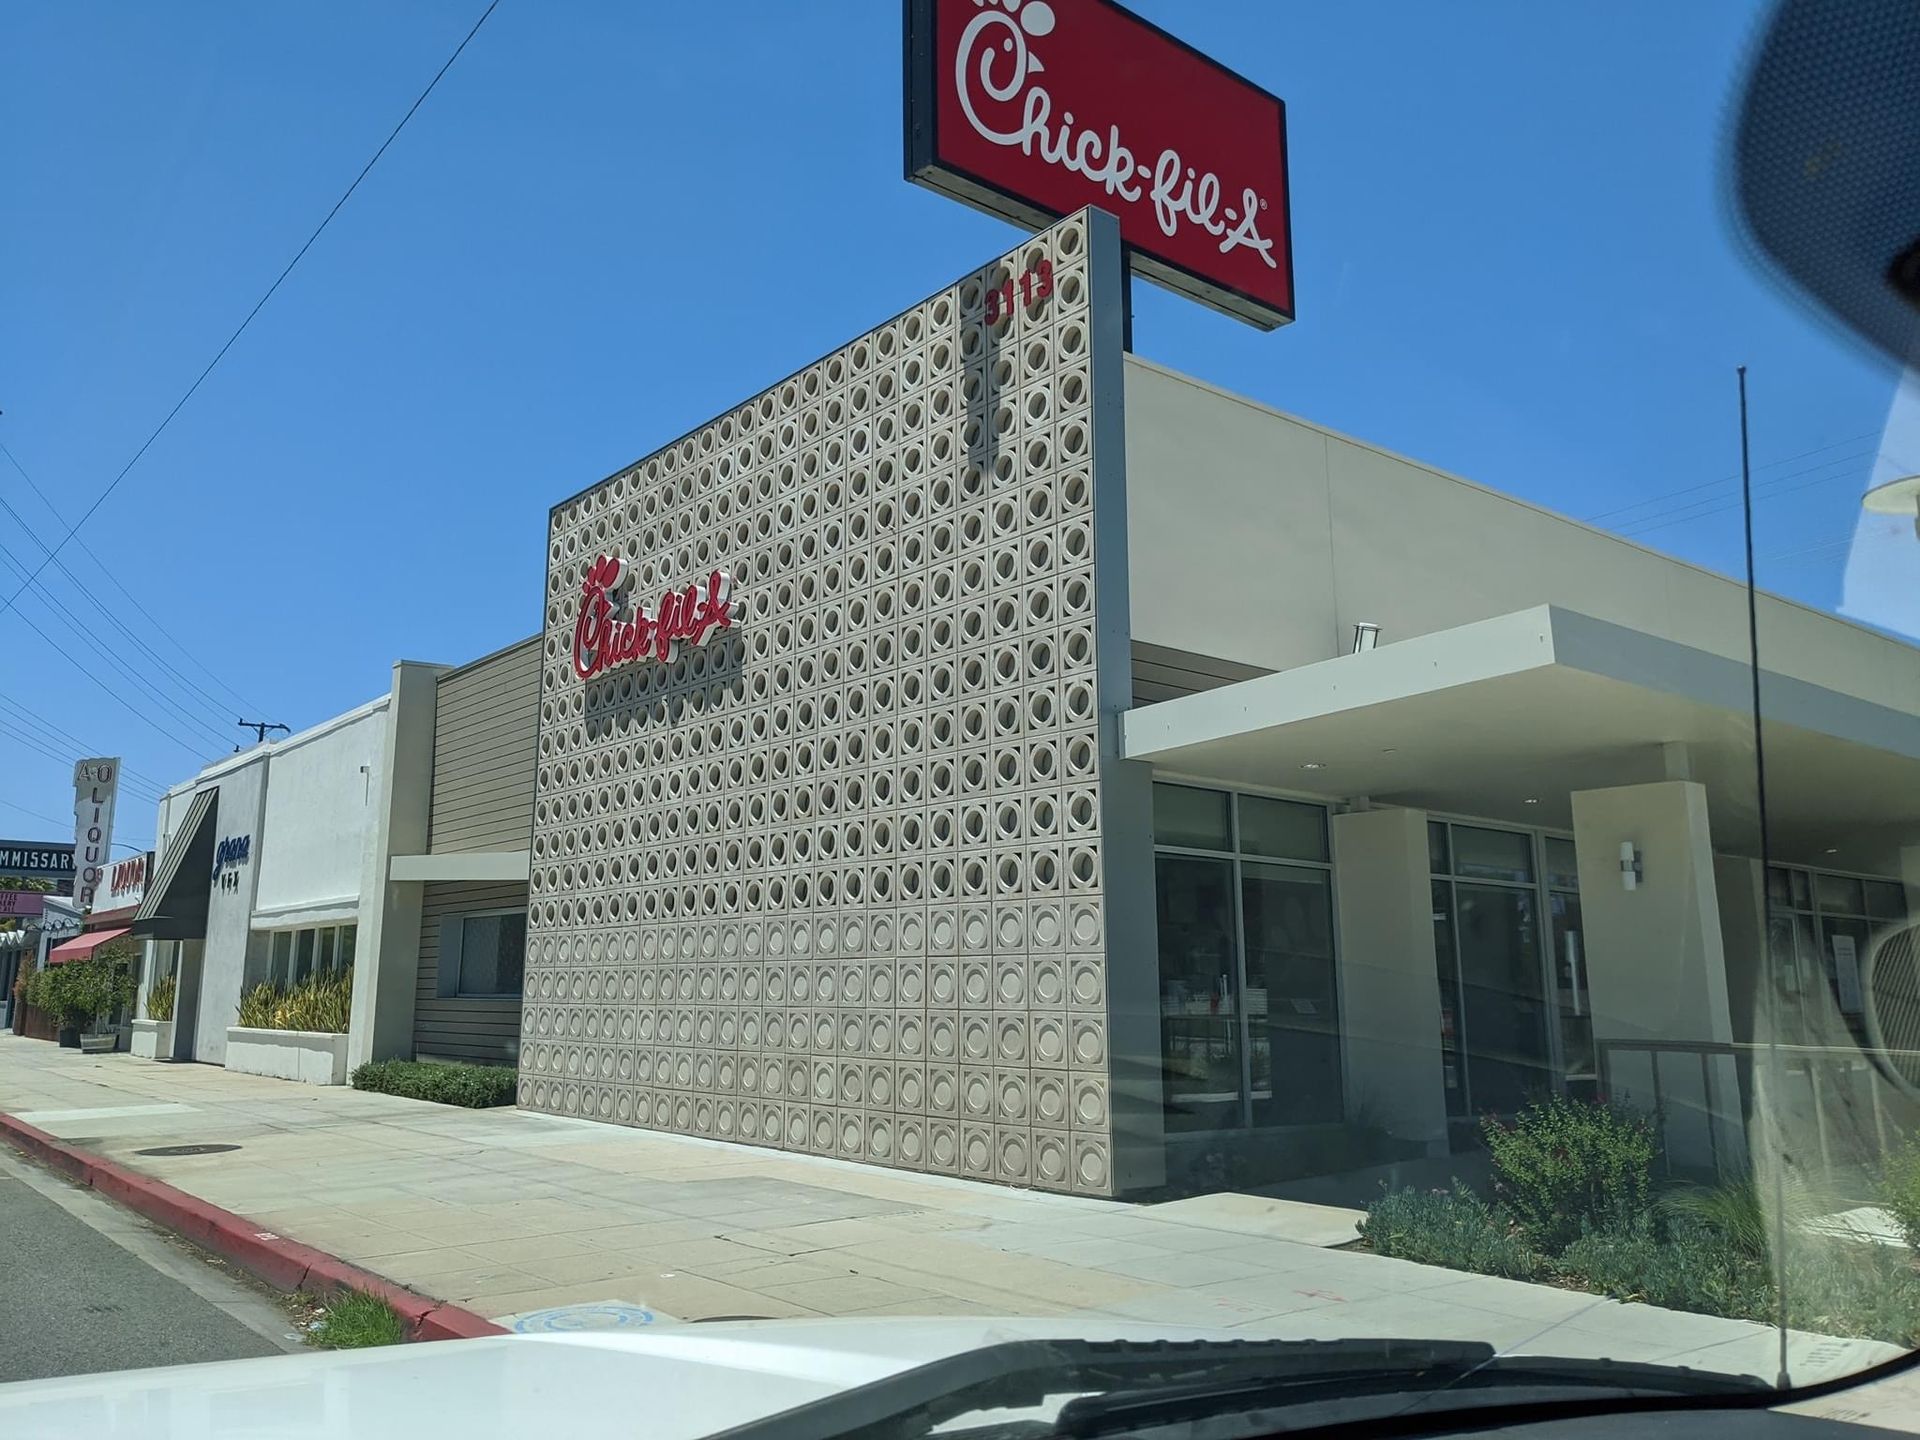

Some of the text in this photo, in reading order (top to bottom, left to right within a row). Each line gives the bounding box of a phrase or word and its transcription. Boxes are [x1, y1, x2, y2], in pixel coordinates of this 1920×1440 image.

[955, 4, 1277, 268] Chick-fil-A
[984, 259, 1053, 326] 3113
[574, 560, 736, 680] Chick-fil-A
[79, 787, 104, 903] LIQUOR
